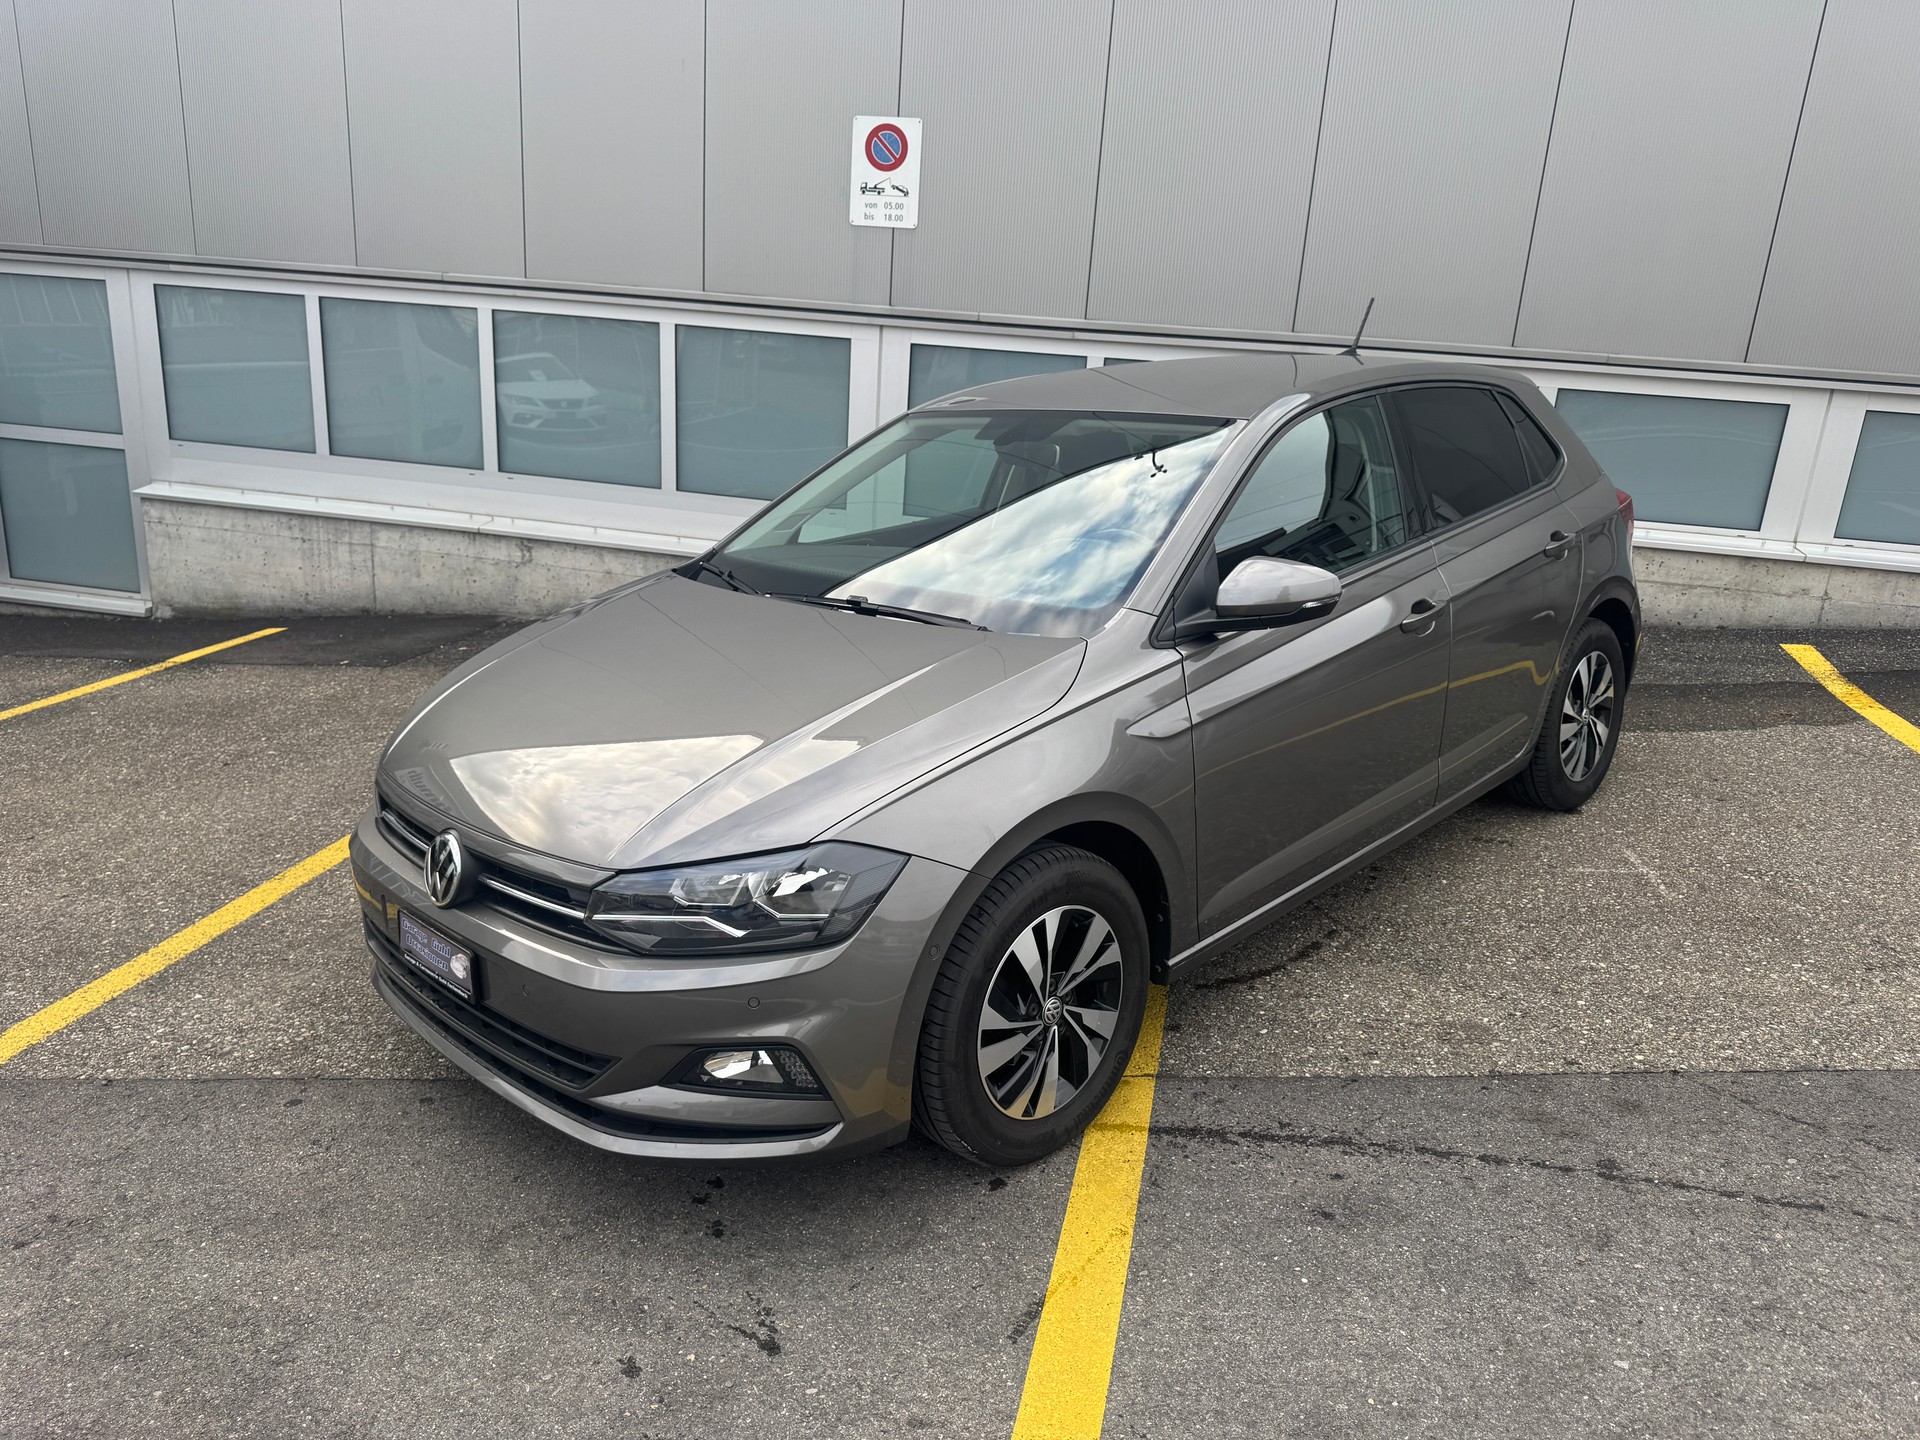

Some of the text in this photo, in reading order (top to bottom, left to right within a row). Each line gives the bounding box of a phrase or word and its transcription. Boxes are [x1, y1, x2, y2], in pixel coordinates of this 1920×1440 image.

[883, 202, 905, 211] 05.00
[864, 212, 904, 222] bis 18.00
[402, 917, 428, 943] Garage
